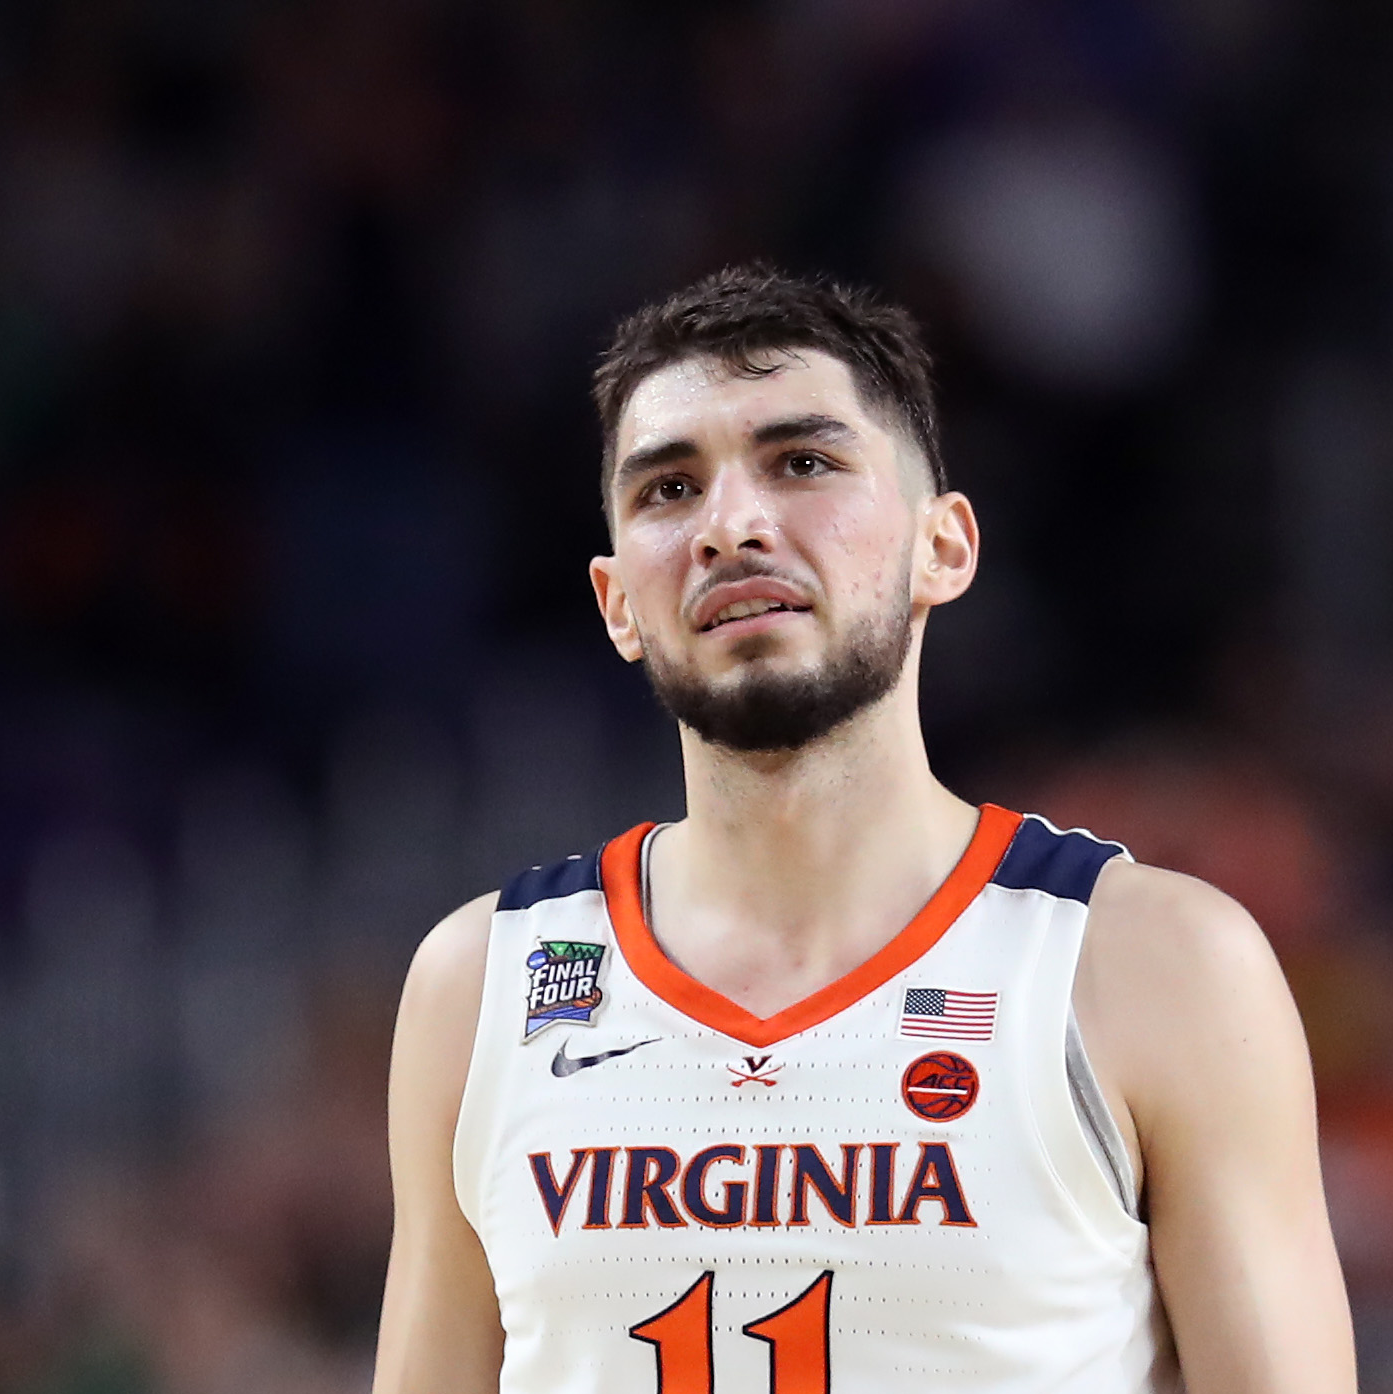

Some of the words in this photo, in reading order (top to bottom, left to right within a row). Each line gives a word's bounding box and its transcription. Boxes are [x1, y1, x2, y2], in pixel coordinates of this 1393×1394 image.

[533, 959, 596, 988] FINAL
[530, 977, 593, 1010] FOUR
[527, 1141, 978, 1238] VIRGINIA
